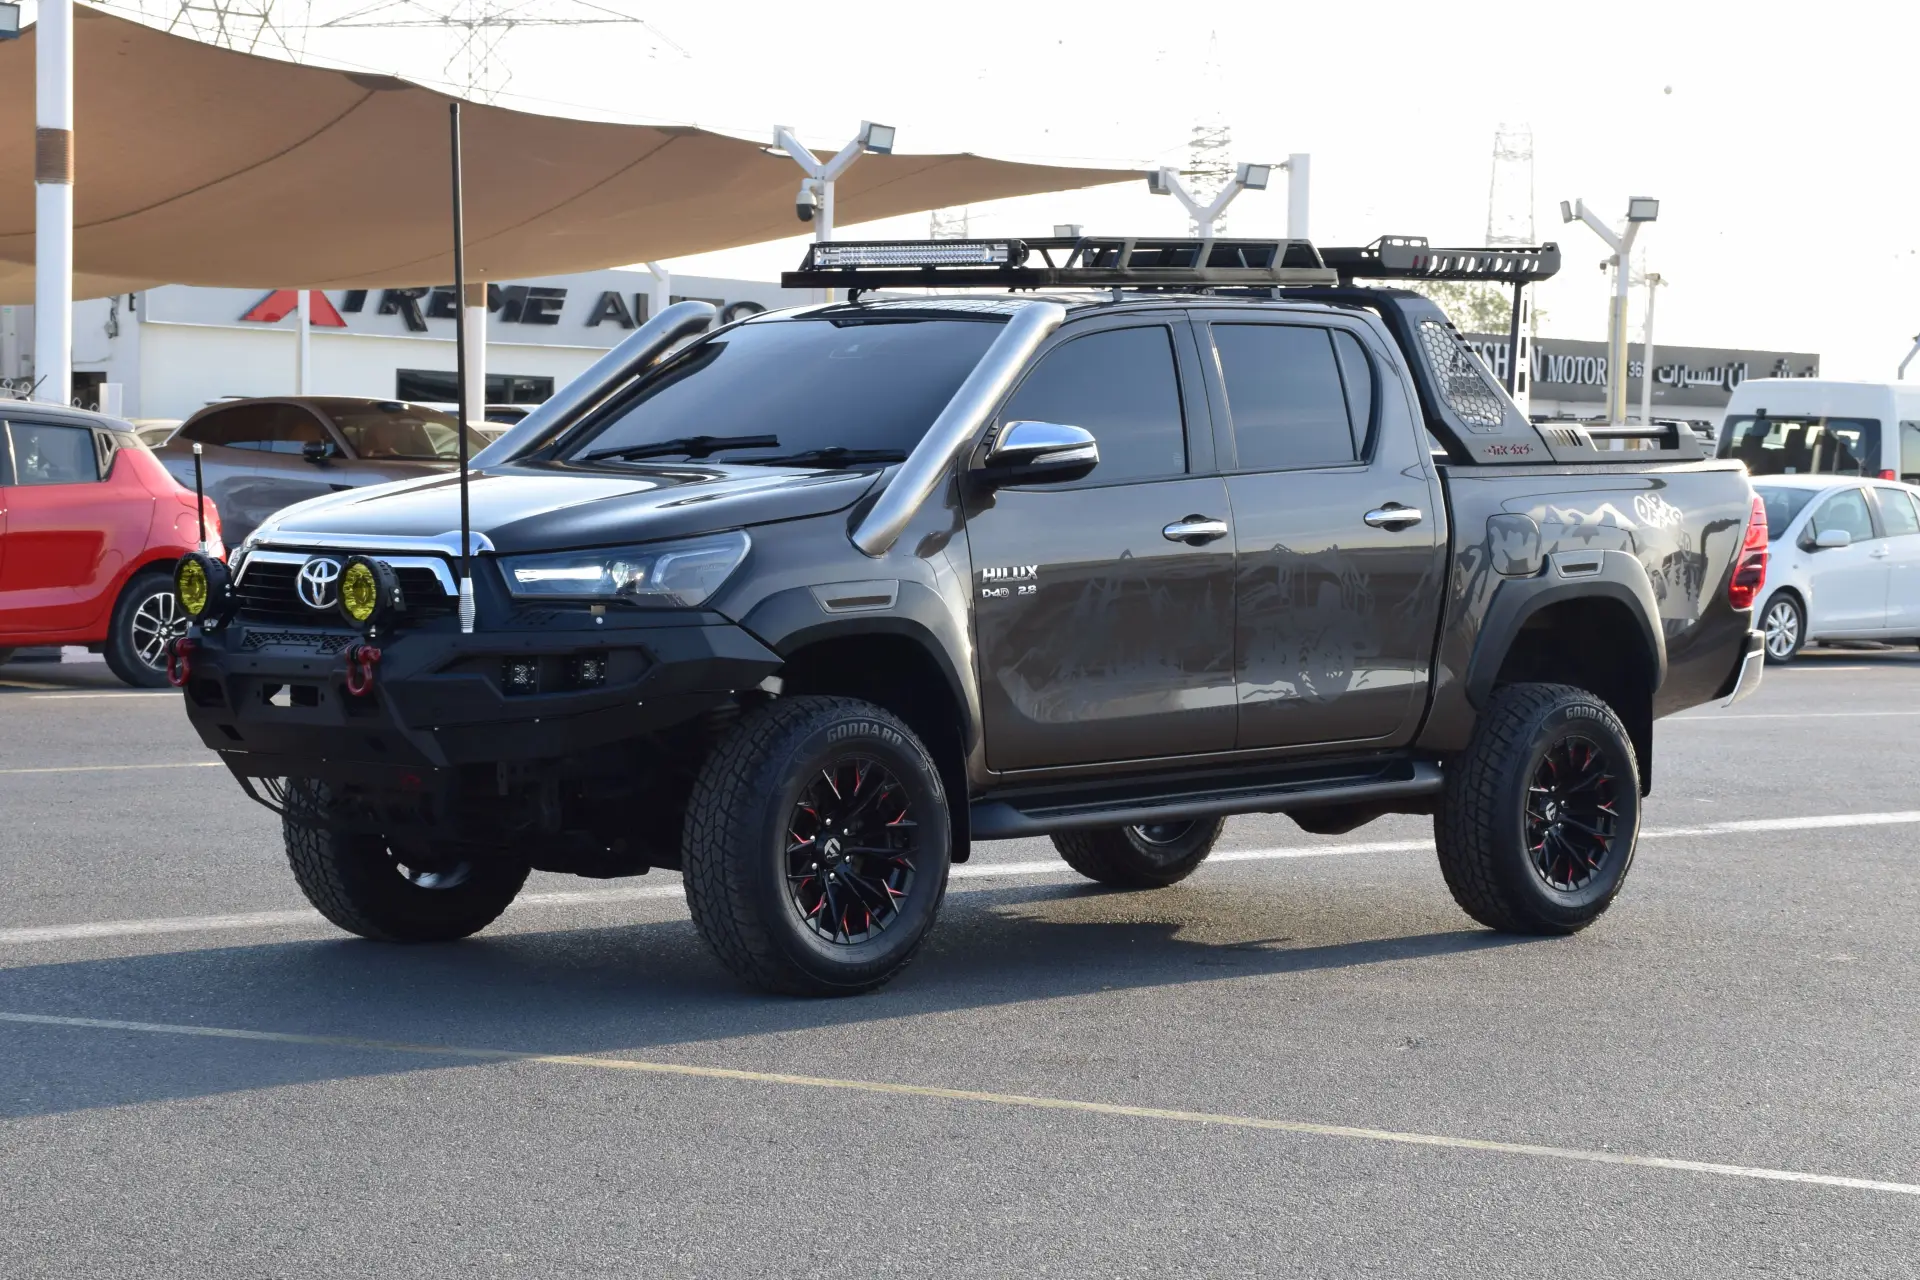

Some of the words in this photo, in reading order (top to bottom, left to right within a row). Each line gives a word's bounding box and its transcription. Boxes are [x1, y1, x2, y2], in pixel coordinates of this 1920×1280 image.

[982, 564, 1038, 582] HILUX
[1565, 706, 1619, 734] GODDARD
[826, 722, 903, 745] GODDARD
